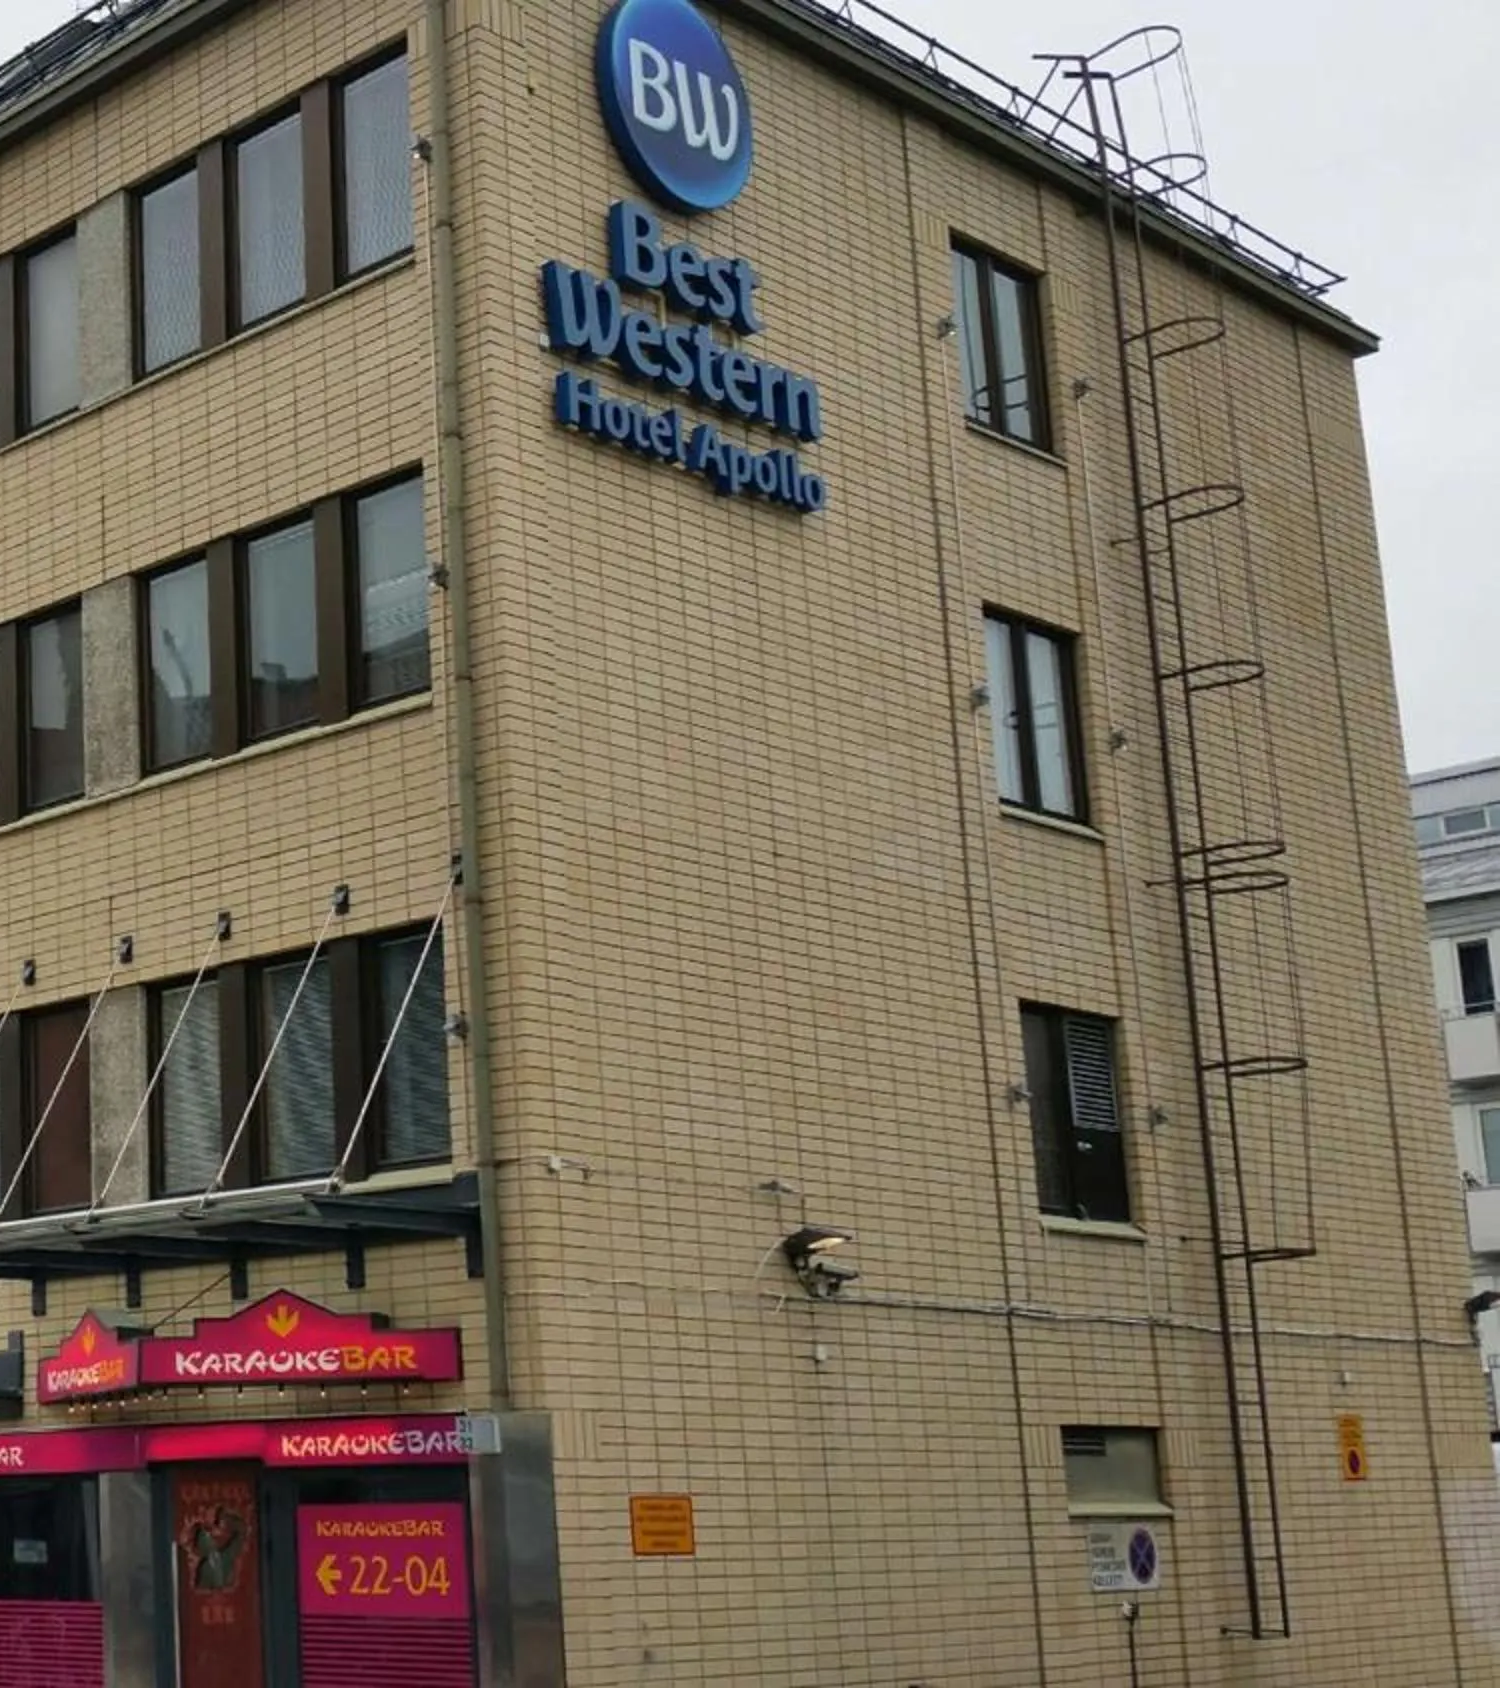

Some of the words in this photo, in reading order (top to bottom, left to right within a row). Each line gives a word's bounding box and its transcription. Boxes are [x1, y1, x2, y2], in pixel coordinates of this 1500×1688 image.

[628, 38, 739, 162] BW
[611, 202, 763, 334] Best
[542, 260, 823, 441] Western
[556, 371, 687, 463] Hotel
[690, 424, 827, 513] Apollo
[175, 1345, 418, 1376] KARAOKEBAR
[350, 1555, 451, 1597] 22-04
